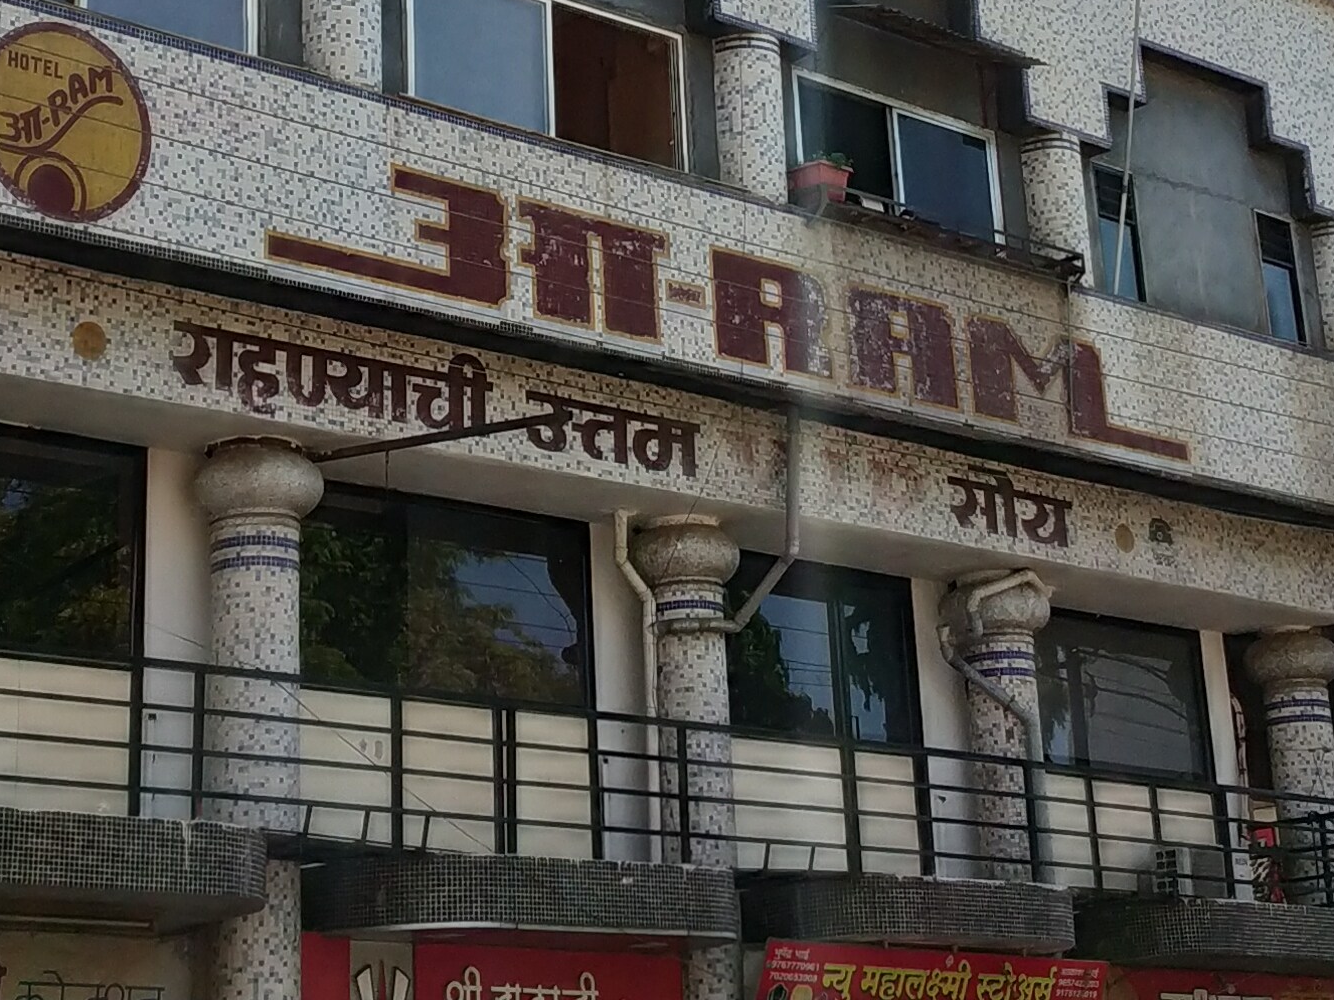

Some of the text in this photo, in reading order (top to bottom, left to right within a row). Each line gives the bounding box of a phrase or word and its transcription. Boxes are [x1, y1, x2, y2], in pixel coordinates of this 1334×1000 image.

[8, 50, 63, 79] HOTEL
[173, 320, 494, 430] राहण्याची
[525, 389, 700, 478] उत्तम
